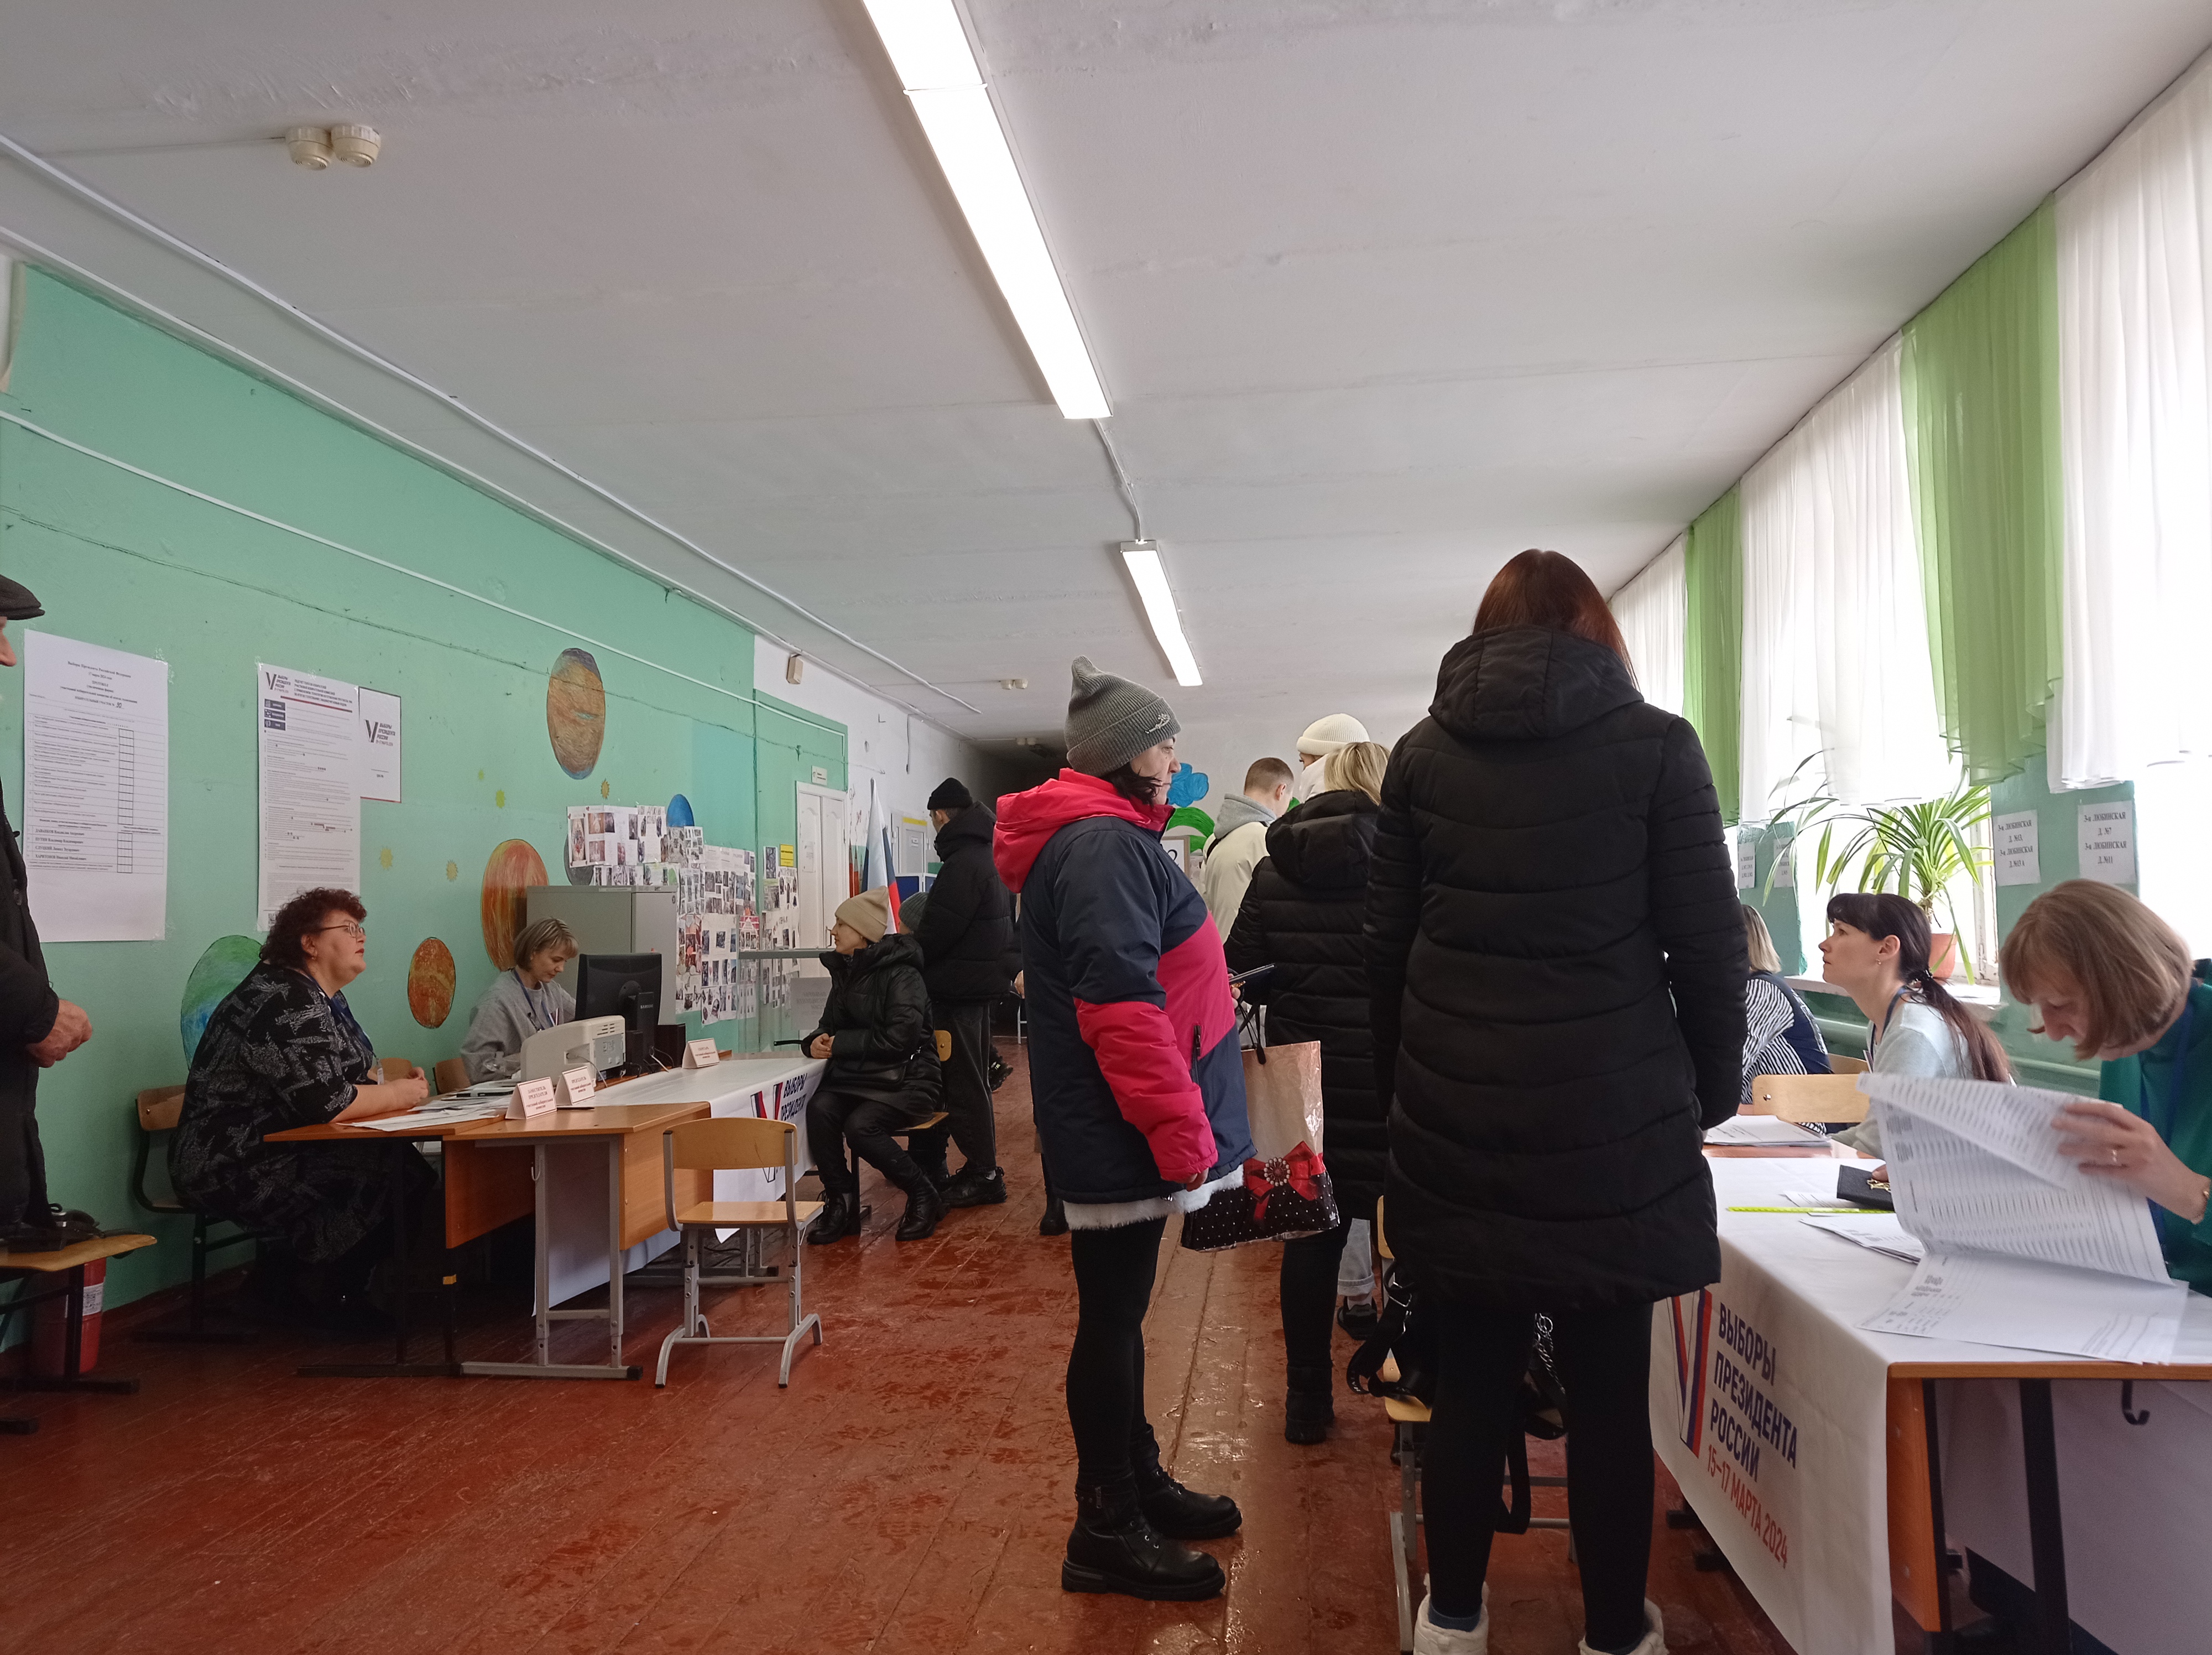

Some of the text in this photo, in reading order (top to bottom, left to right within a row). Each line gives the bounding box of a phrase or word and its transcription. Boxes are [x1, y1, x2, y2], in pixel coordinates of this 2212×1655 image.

[783, 1073, 807, 1099] ВЫБОРЫ
[1719, 1302, 1776, 1386] ВЫБОРЫ
[1710, 1398, 1760, 1482] РОССИИ
[1714, 1350, 1797, 1470] ПРЕЗИДЕНТА
[1730, 1472, 1761, 1537] МАРТА
[1762, 1512, 1788, 1569] 2024
